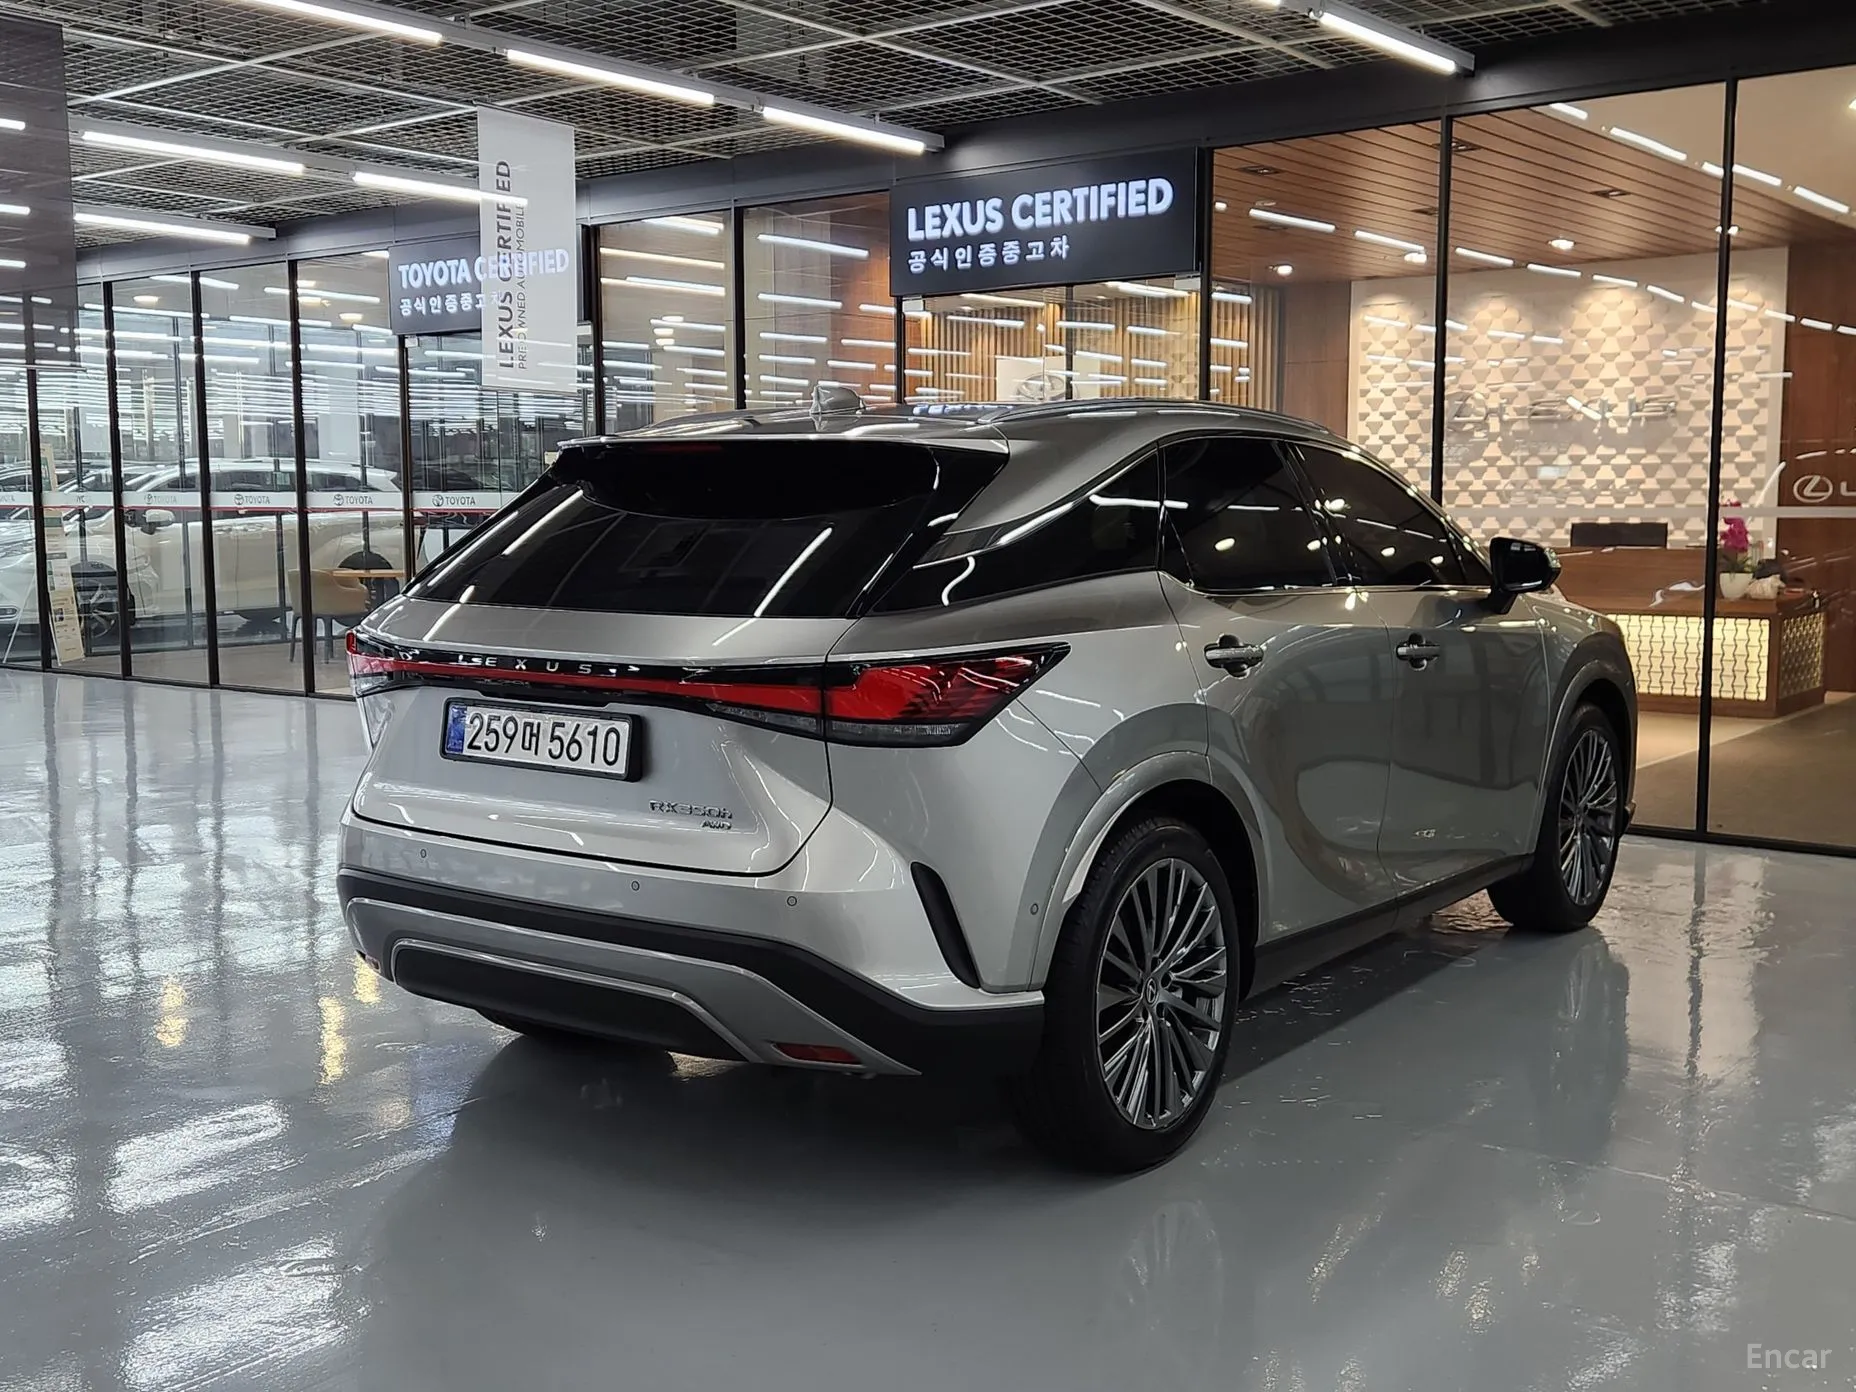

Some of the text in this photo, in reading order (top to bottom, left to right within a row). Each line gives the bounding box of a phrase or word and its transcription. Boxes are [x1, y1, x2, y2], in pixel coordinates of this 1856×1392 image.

[907, 177, 1175, 242] LEXUS CERTIFIED
[496, 159, 514, 369] LEXUS CERTIFED
[907, 234, 1071, 274] 공식인증중고차
[397, 258, 472, 290] TOYOTA
[244, 496, 271, 505] TOYOTA
[345, 496, 373, 505] TOYOTA
[445, 496, 476, 505] TOYOTA
[458, 654, 592, 675] LEXUS
[548, 722, 621, 767] 5610
